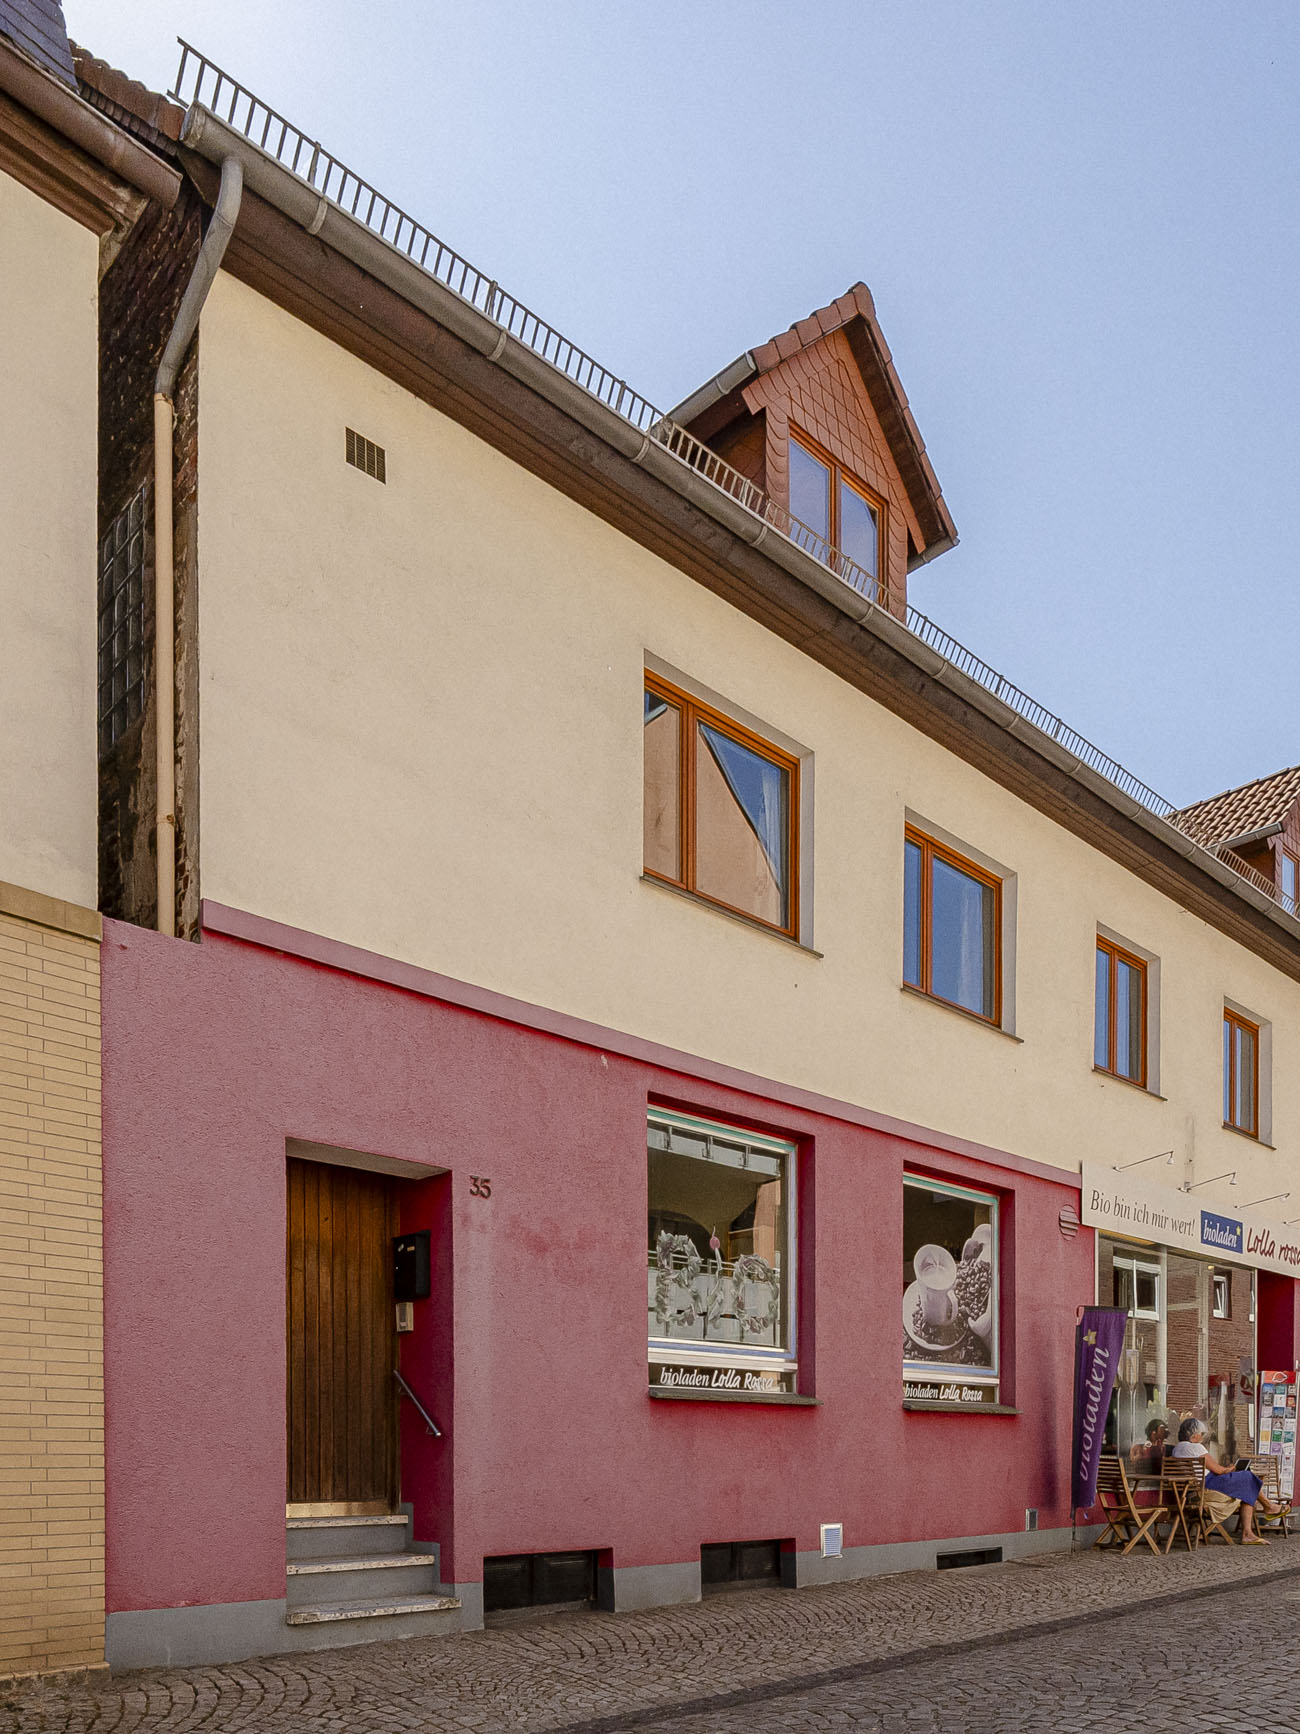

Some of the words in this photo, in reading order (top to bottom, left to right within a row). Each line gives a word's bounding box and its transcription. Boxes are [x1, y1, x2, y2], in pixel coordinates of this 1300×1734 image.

[469, 1174, 492, 1199] 35
[1090, 1189, 1111, 1214] Bio
[1113, 1195, 1131, 1219] bin
[1133, 1201, 1149, 1225] ich
[1151, 1209, 1169, 1229] mir
[1171, 1218, 1195, 1237] wert!
[1203, 1219, 1237, 1248] bioladen
[1246, 1227, 1275, 1259] Lolla
[660, 1366, 710, 1387] bioladen
[711, 1369, 741, 1388] Lolla
[743, 1372, 774, 1391] Rossa
[904, 1383, 938, 1399] bioladen
[939, 1384, 961, 1400] Lolla
[961, 1386, 983, 1401] Rossa
